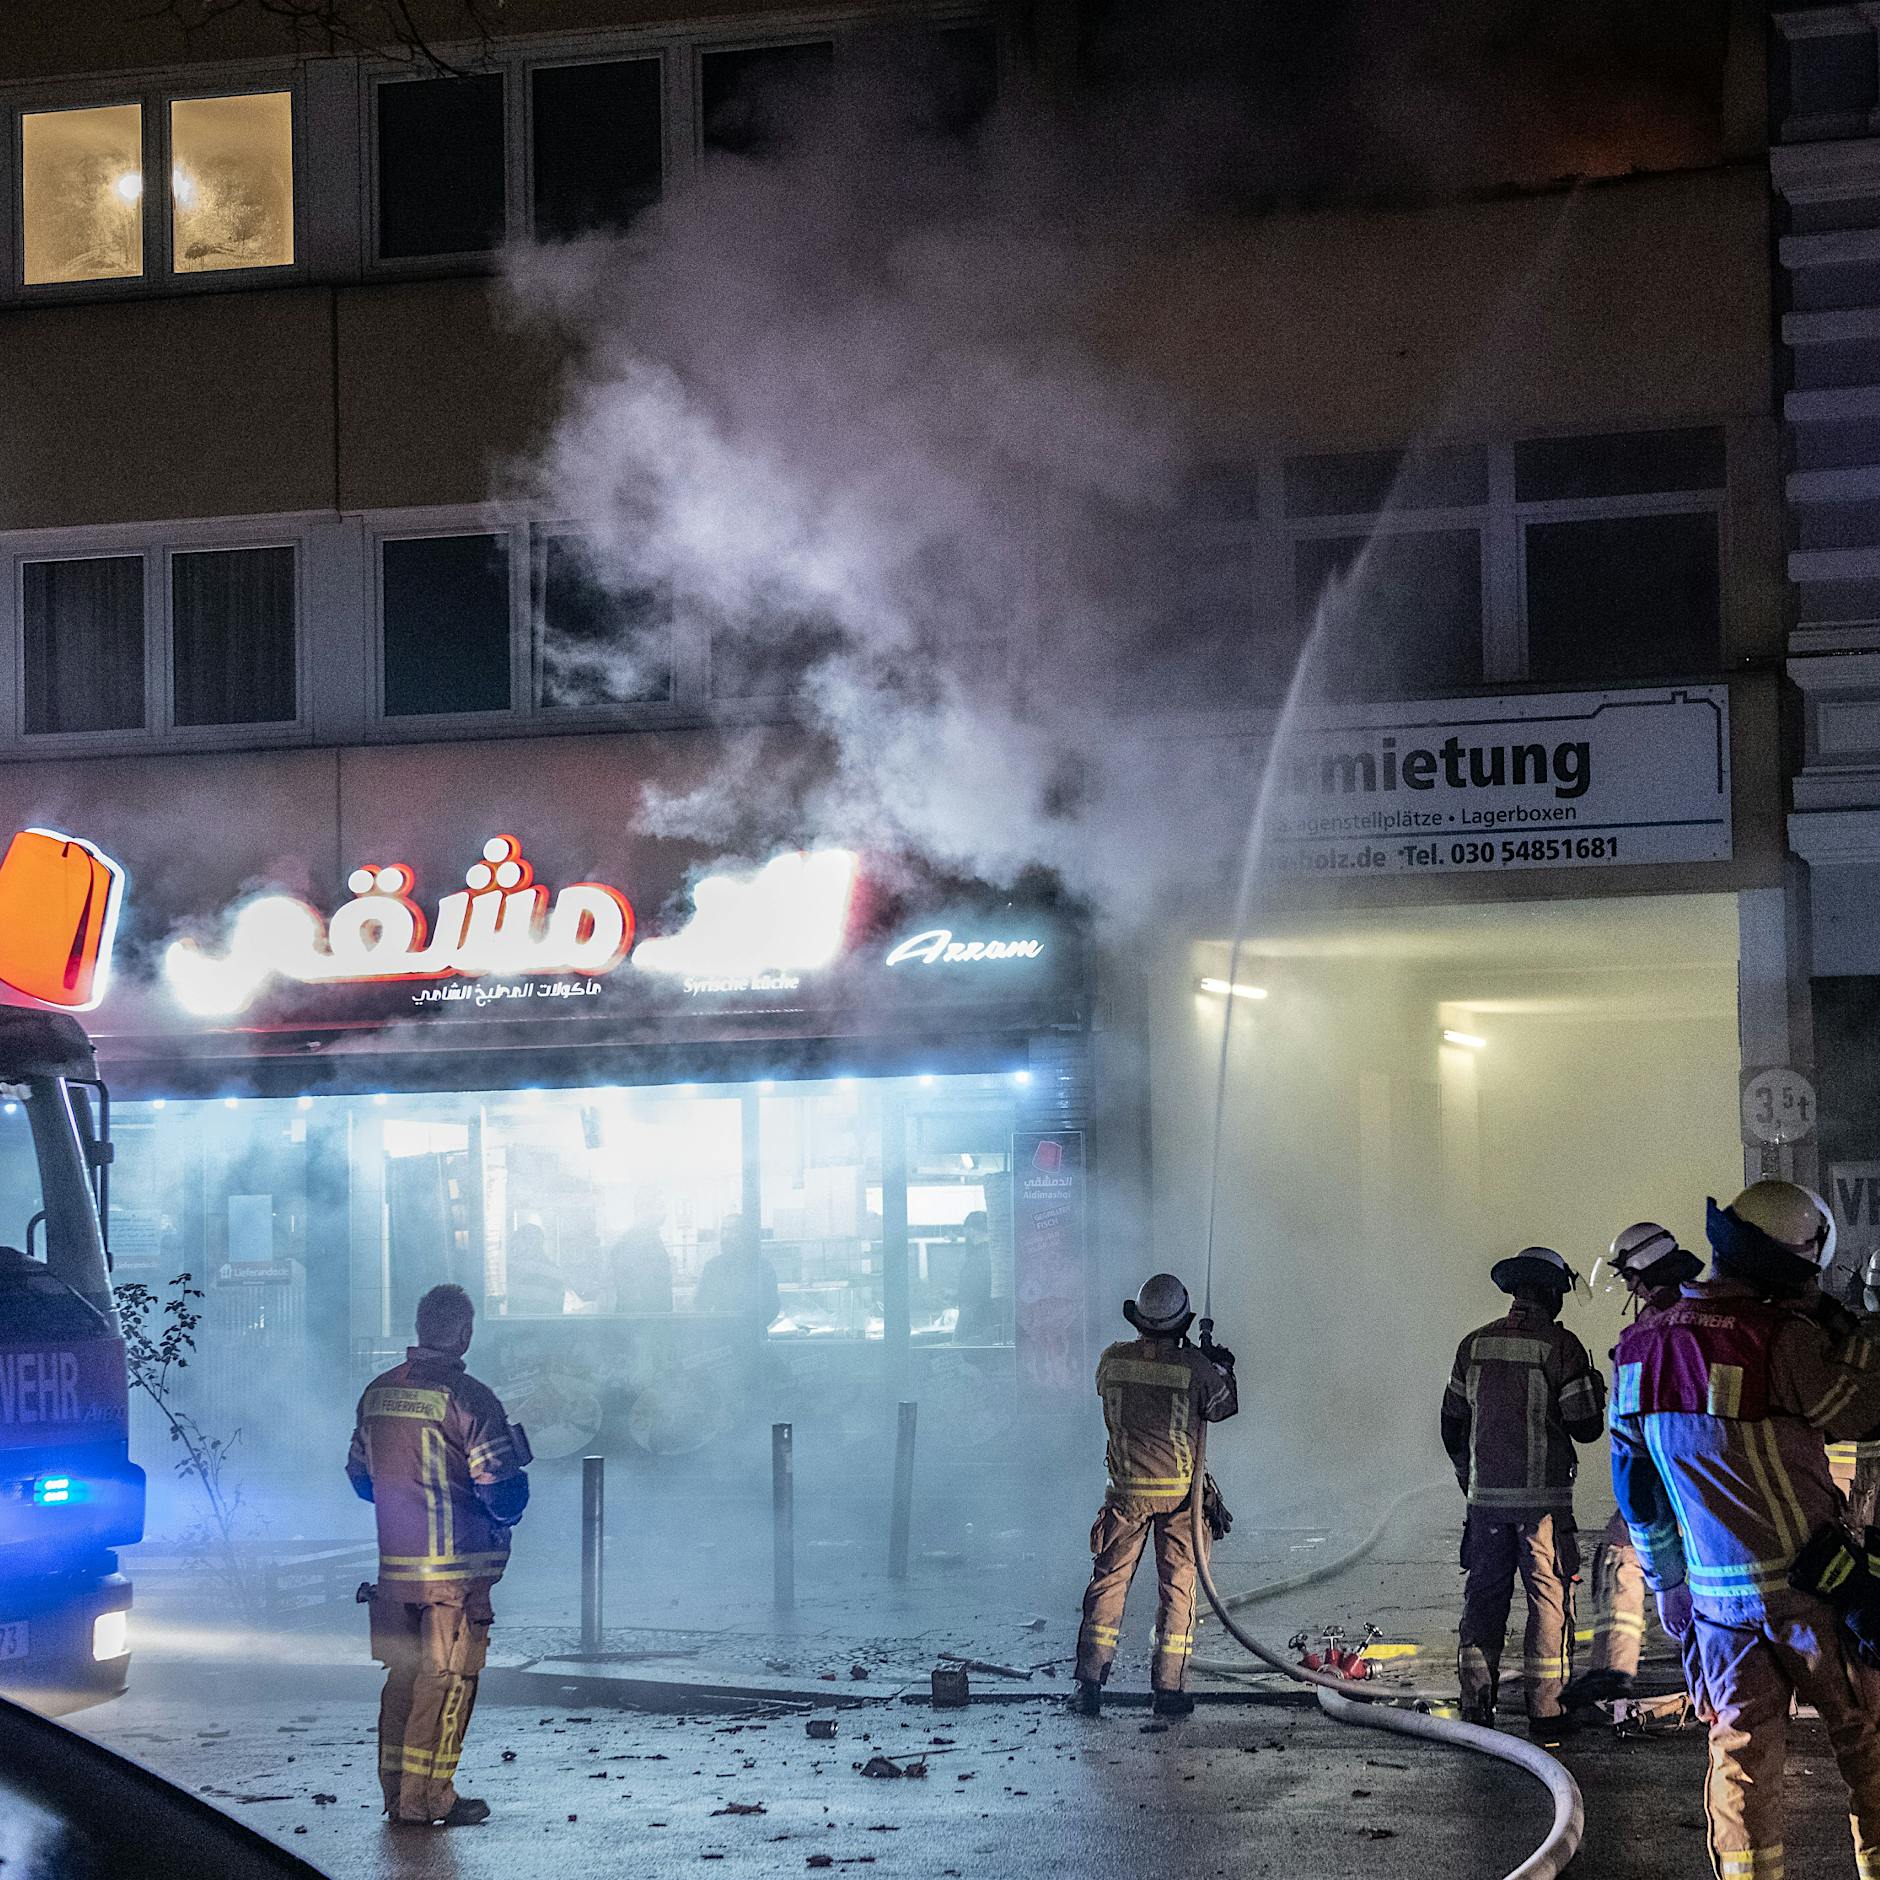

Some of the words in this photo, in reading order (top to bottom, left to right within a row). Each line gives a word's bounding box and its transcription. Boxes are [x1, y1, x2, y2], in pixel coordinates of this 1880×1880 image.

[1461, 806, 1577, 827] Lagerboxen
[1402, 842, 1445, 866] Tel.
[1450, 842, 1495, 865] 030
[1501, 837, 1619, 864] 54851681
[411, 982, 473, 1006] الشامي
